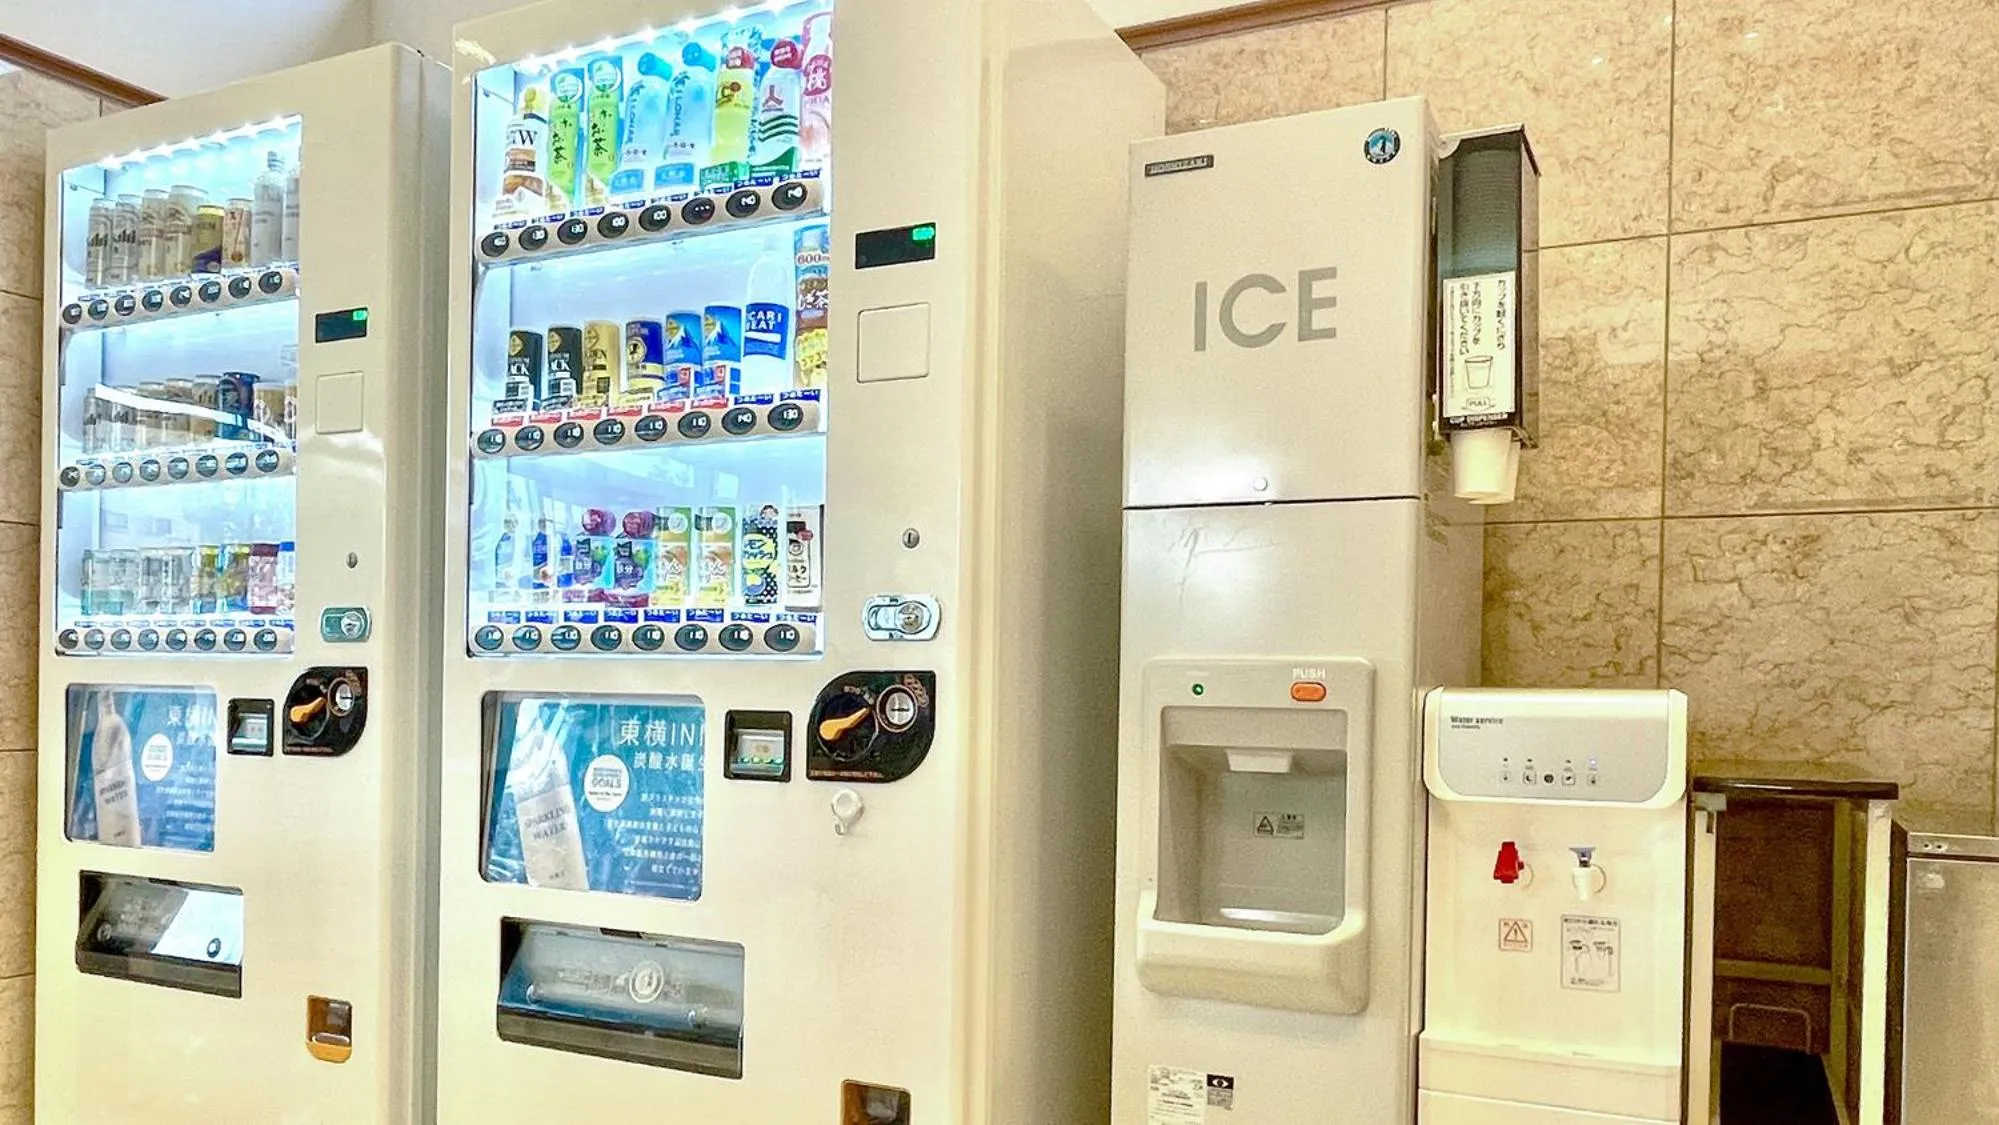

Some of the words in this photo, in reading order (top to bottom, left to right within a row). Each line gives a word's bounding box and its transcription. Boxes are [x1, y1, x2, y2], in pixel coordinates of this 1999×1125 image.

[1195, 266, 1338, 352] ICE
[1292, 667, 1326, 679] PUSH
[1450, 715, 1473, 724] Water
[1475, 717, 1503, 725] service
